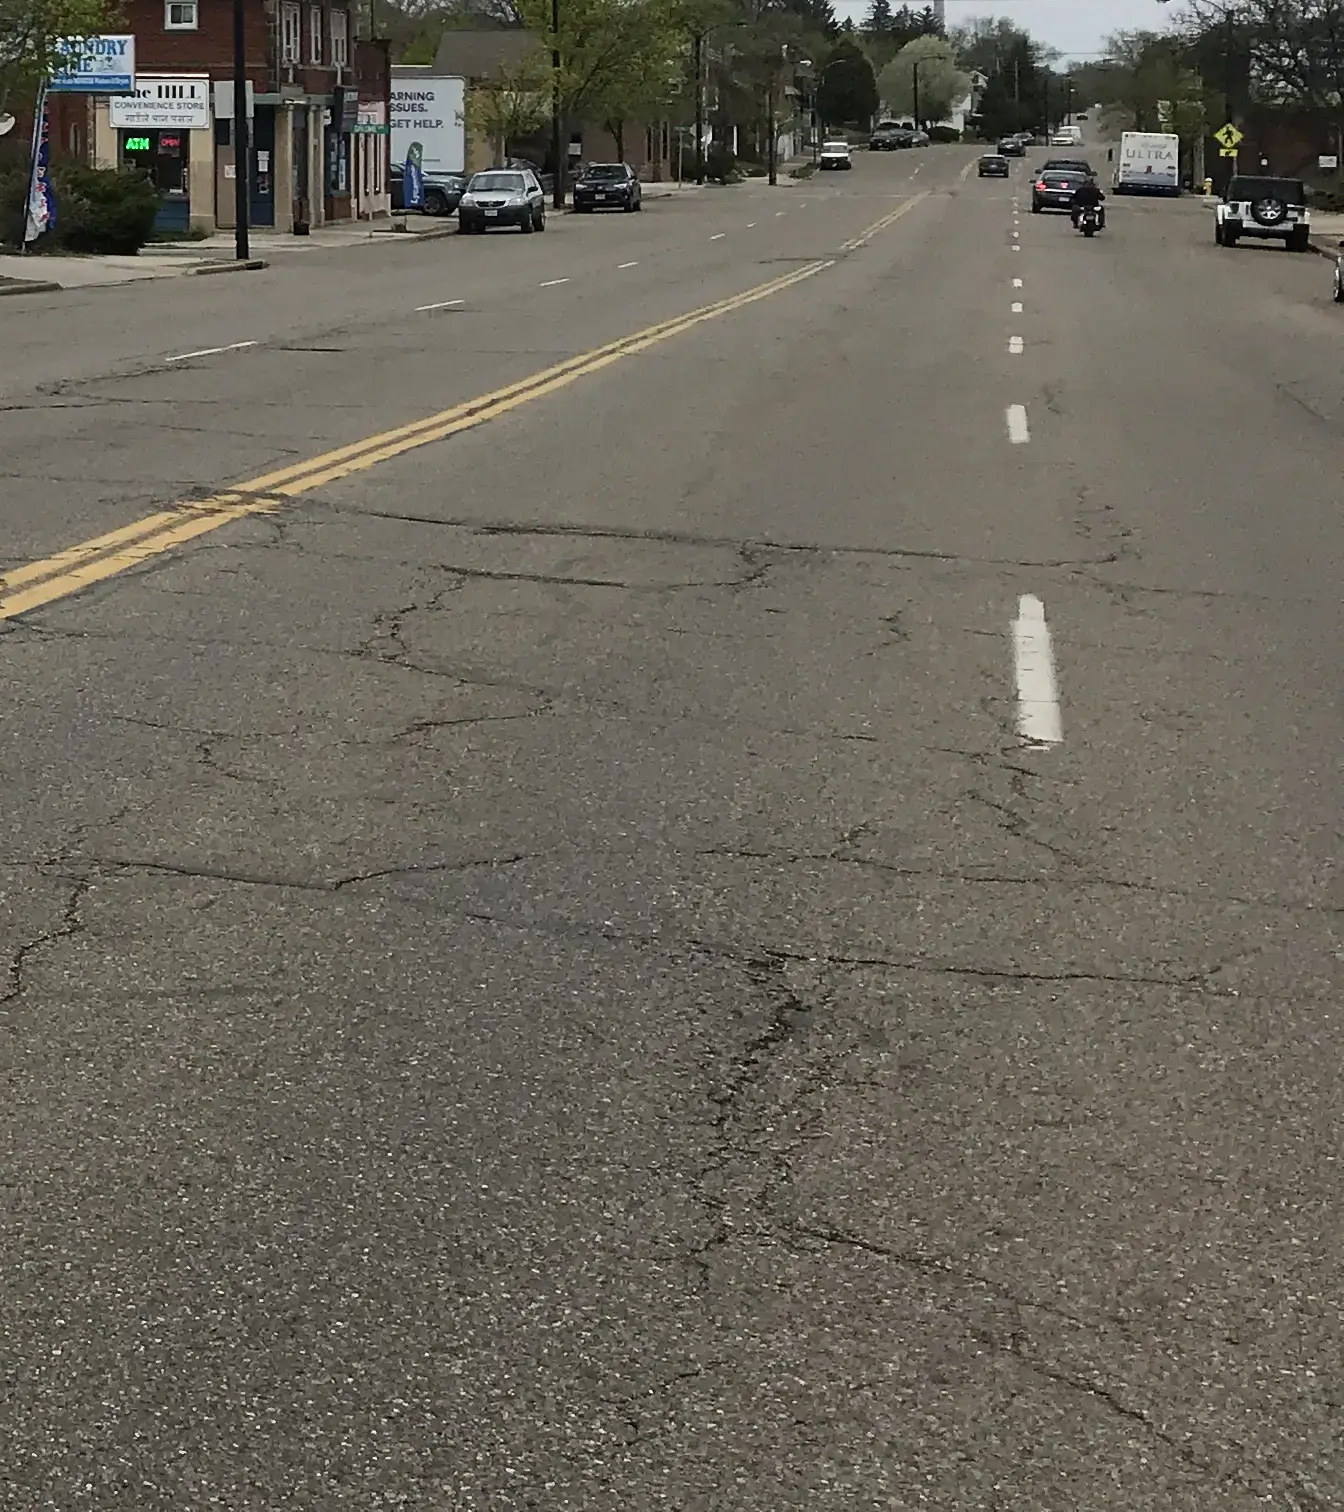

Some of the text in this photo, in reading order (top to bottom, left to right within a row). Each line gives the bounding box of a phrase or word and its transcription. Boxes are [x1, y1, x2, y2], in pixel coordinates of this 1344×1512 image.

[389, 91, 435, 101] ARNING
[114, 101, 205, 110] CONVENIENCE STORE
[389, 103, 429, 113] SSUES.
[413, 119, 445, 129] HELP.
[125, 137, 150, 150] ATM
[1126, 149, 1173, 160] ULTRA
